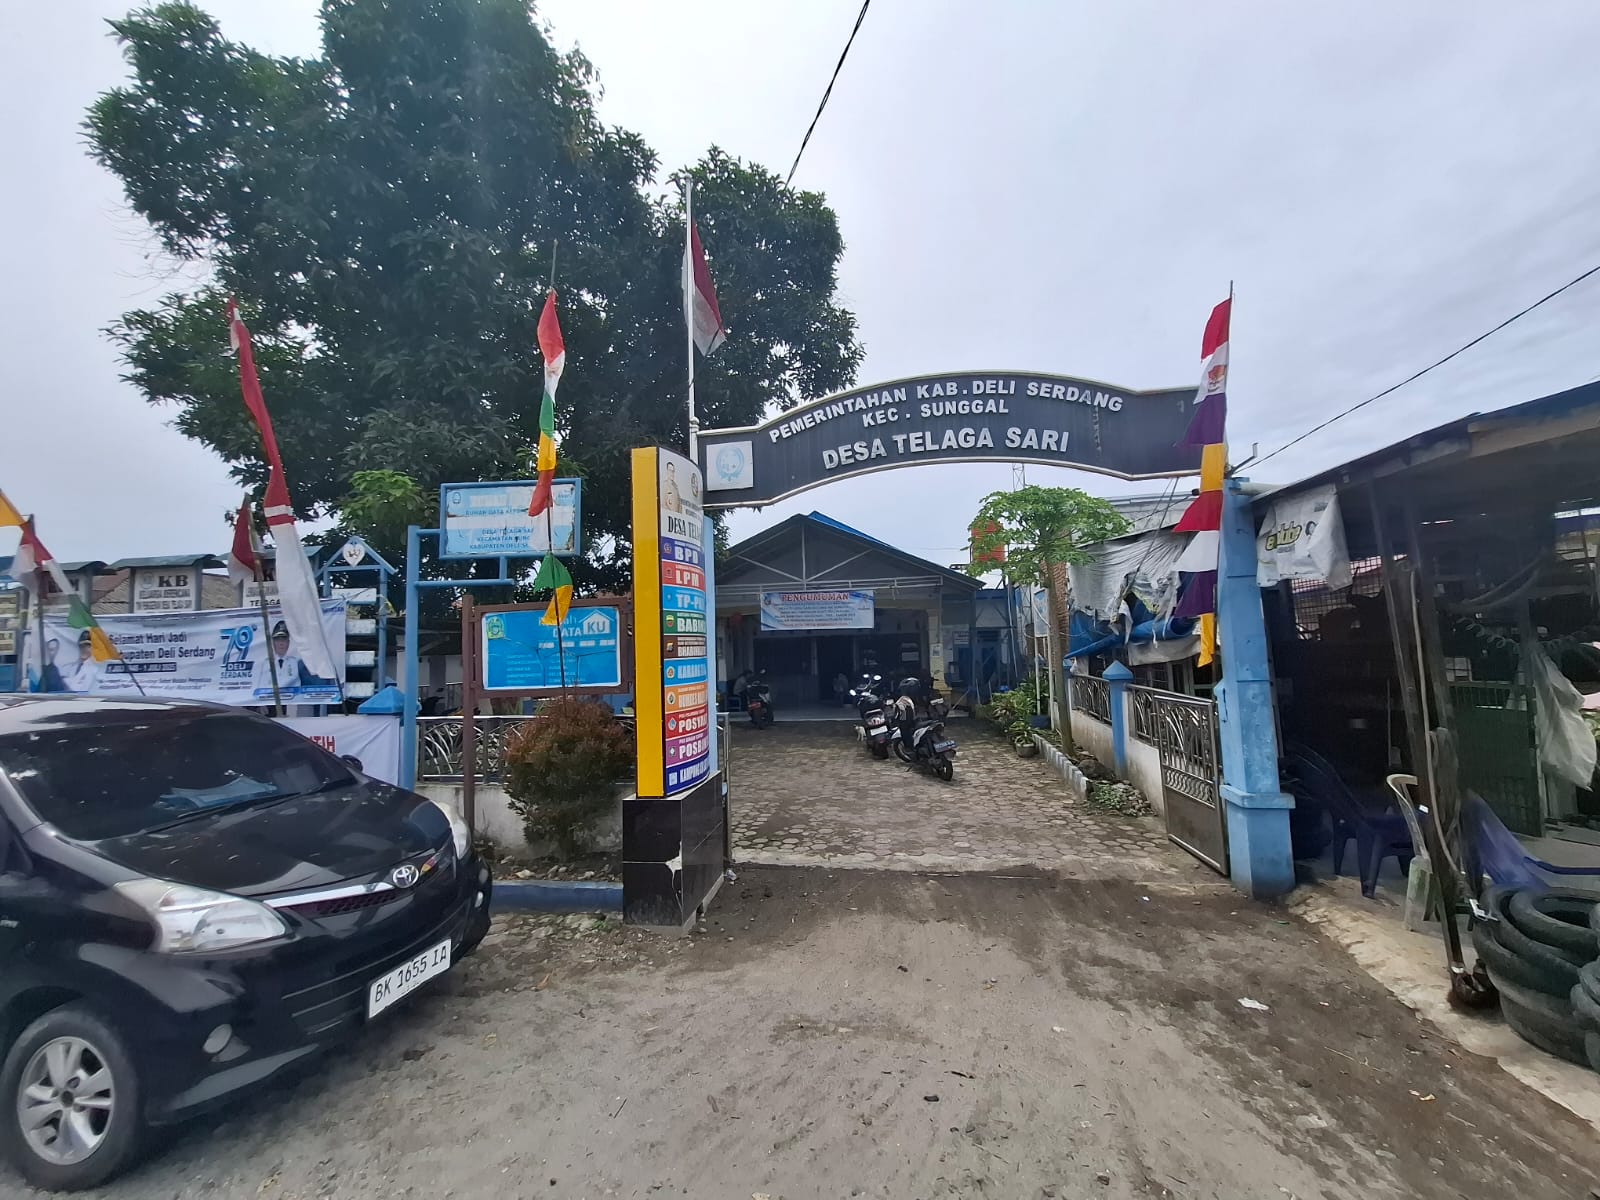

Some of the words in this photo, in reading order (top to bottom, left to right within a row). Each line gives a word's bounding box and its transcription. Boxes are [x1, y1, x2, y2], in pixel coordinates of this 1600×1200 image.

[769, 388, 907, 443] PEMERINTAHAN
[972, 380, 1016, 395] DELI
[1026, 382, 1123, 412] SERDANG
[920, 399, 1009, 418] SUNGGAL
[822, 438, 888, 470] DESA
[892, 427, 994, 454] TELAGA
[1005, 426, 1070, 452] SARI
[667, 516, 686, 537] DESA
[675, 546, 698, 564] BPD
[158, 574, 188, 587] KB
[676, 570, 699, 588] LPM
[783, 592, 849, 602] PENGUMUMAN
[587, 621, 606, 633] KU
[146, 631, 165, 643] Hari
[168, 631, 187, 643] Jadi
[158, 646, 175, 658] Deli
[178, 646, 216, 660] Serdang
[227, 662, 248, 671] DELI
[221, 671, 253, 679] SERDANG
[375, 976, 392, 1003] BK
[396, 955, 428, 989] 1655
[431, 945, 447, 968] IA
